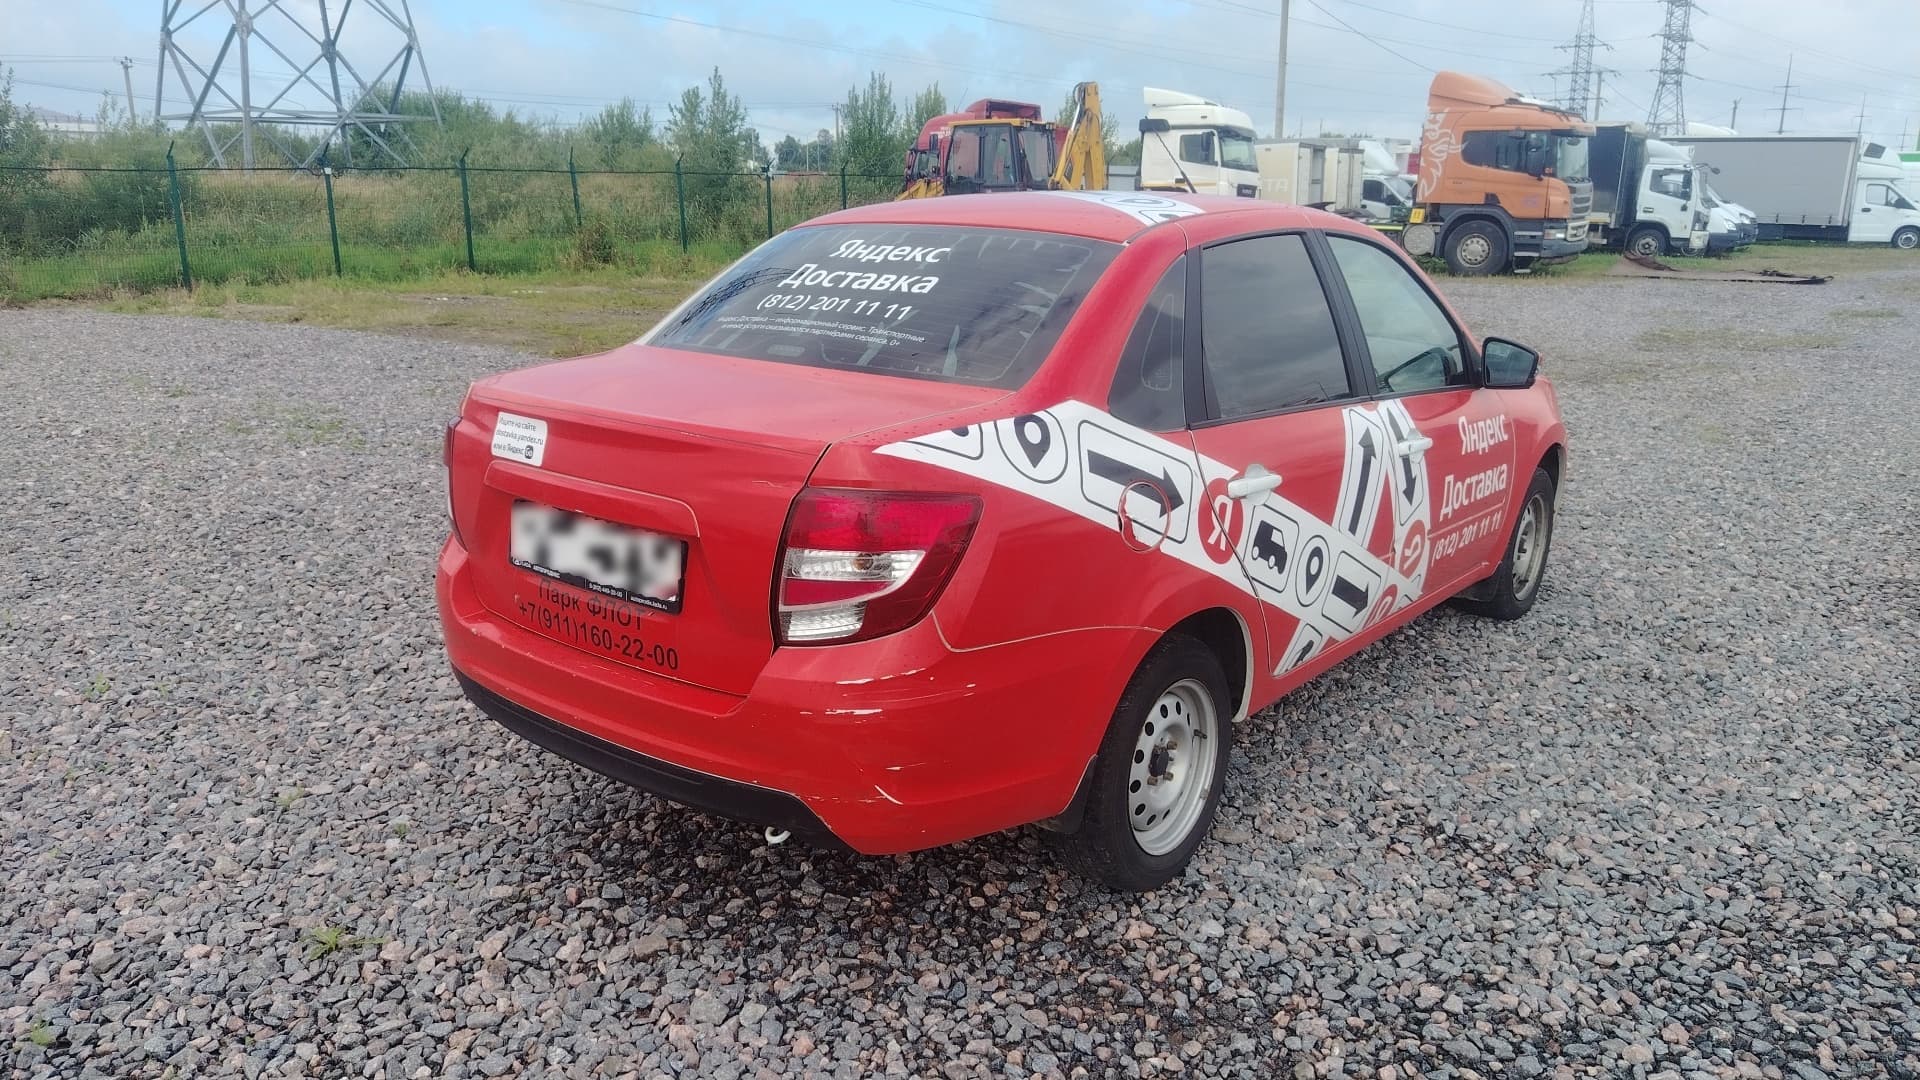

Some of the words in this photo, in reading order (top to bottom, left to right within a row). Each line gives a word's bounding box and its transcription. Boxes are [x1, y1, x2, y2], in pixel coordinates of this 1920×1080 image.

[829, 239, 951, 263] Яндекс
[777, 263, 939, 294] Доставка
[756, 294, 811, 311] (812)
[808, 295, 851, 312] 201
[854, 300, 880, 316] 11
[884, 303, 912, 320] 11
[522, 422, 536, 432] сайте
[1458, 413, 1509, 456] Яндекс
[1439, 463, 1508, 522] Доставка
[1207, 494, 1233, 552] Я
[1431, 531, 1459, 568] (812)
[1458, 522, 1478, 549] 201
[1478, 515, 1491, 539] 11
[1490, 509, 1503, 533] 11
[539, 577, 581, 611] Парк
[586, 594, 646, 631] ФЛОТ
[519, 600, 679, 670] +7(911)160-22-00
